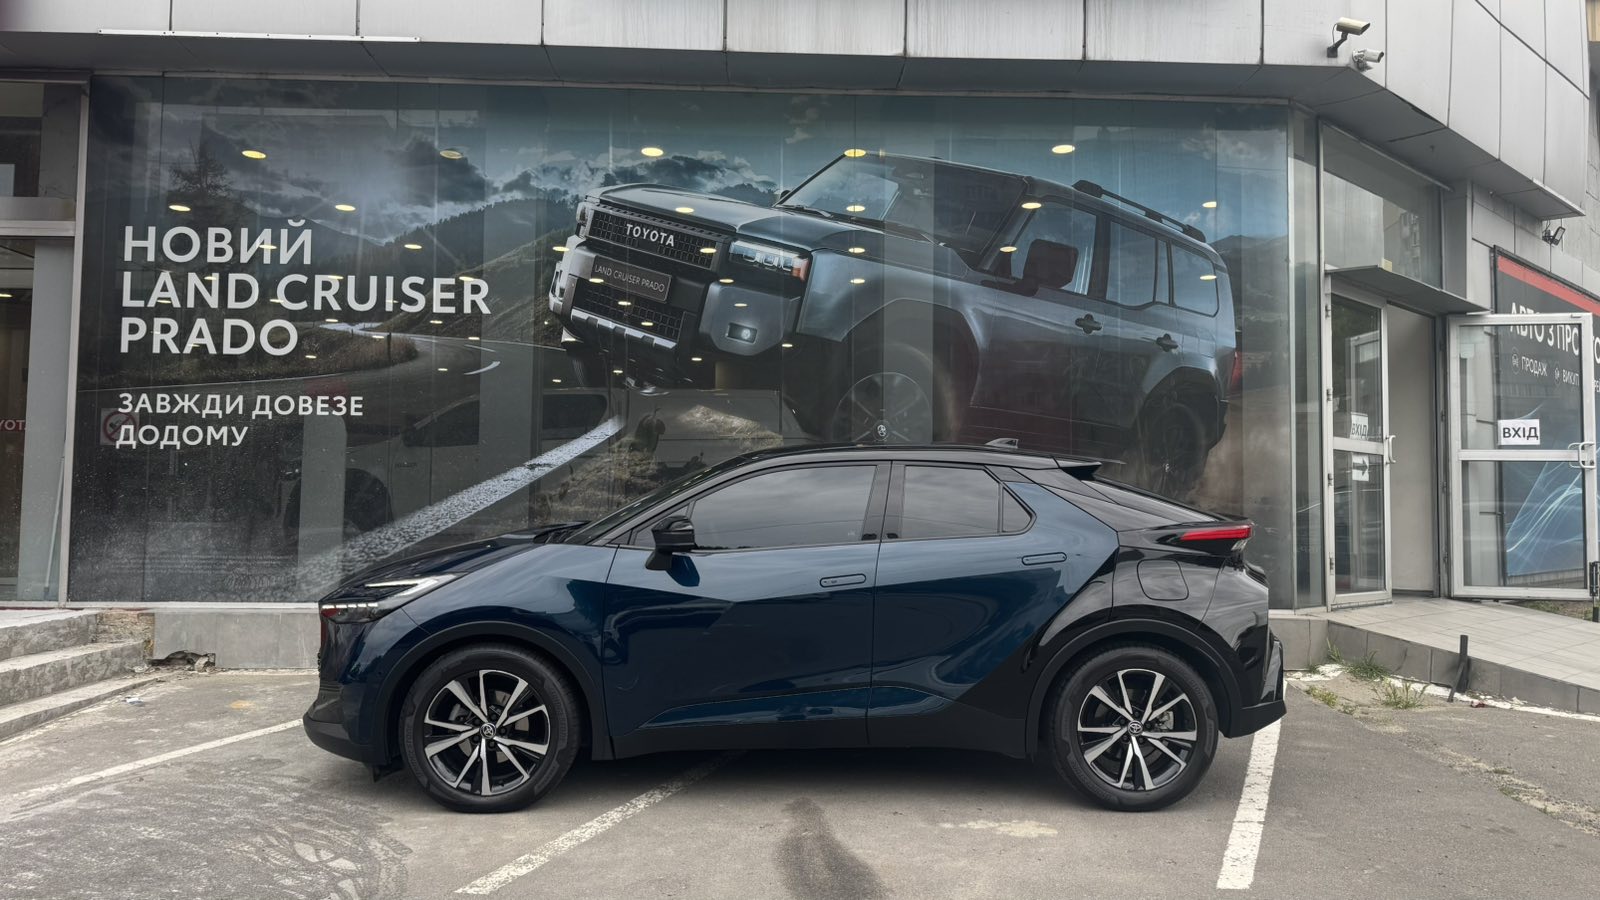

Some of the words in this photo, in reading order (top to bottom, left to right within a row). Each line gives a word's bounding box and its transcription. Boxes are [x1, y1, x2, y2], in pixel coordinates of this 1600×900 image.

[123, 219, 312, 265] НОВИЙ
[626, 224, 675, 247] TOYOTA
[594, 264, 612, 277] LAND
[613, 270, 641, 286] CRUISER
[641, 278, 665, 293] PRADO
[122, 271, 259, 309] LAND
[276, 273, 491, 315] CRUISER
[120, 317, 298, 356] PRADO
[1521, 356, 1548, 378] ПРОДАЖ
[118, 393, 244, 418] ЗАВЖДИ
[251, 395, 364, 420] ДОВЕЗЕ
[116, 425, 248, 450] ДОДОМУ
[1502, 426, 1539, 441] ВХІД
